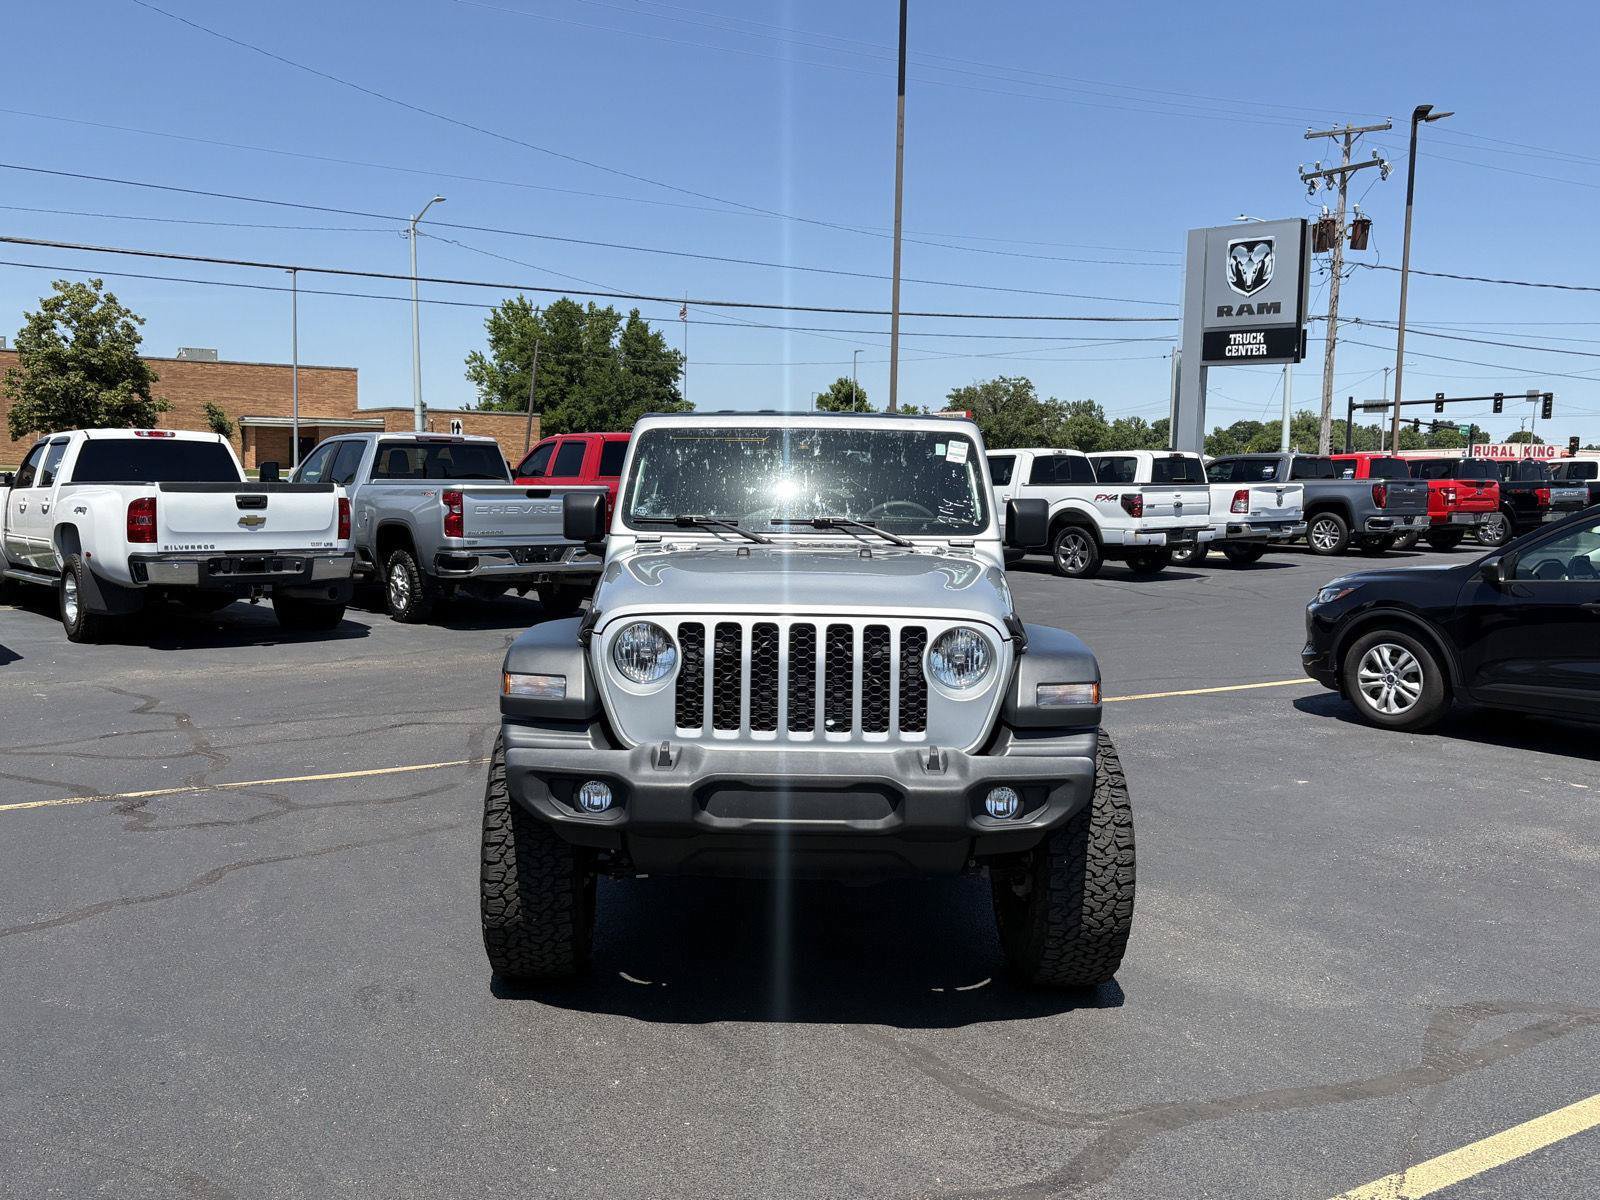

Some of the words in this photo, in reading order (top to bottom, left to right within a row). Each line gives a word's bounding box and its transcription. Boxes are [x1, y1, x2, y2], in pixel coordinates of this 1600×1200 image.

[1216, 301, 1282, 318] RAM
[1229, 332, 1265, 345] TRUCK
[1225, 344, 1268, 357] CENTER
[1473, 445, 1516, 457] RURAL
[1523, 445, 1555, 457] KING
[1094, 493, 1119, 501] FX4
[474, 504, 563, 515] CHEVRO
[163, 543, 216, 551] SILVERADO
